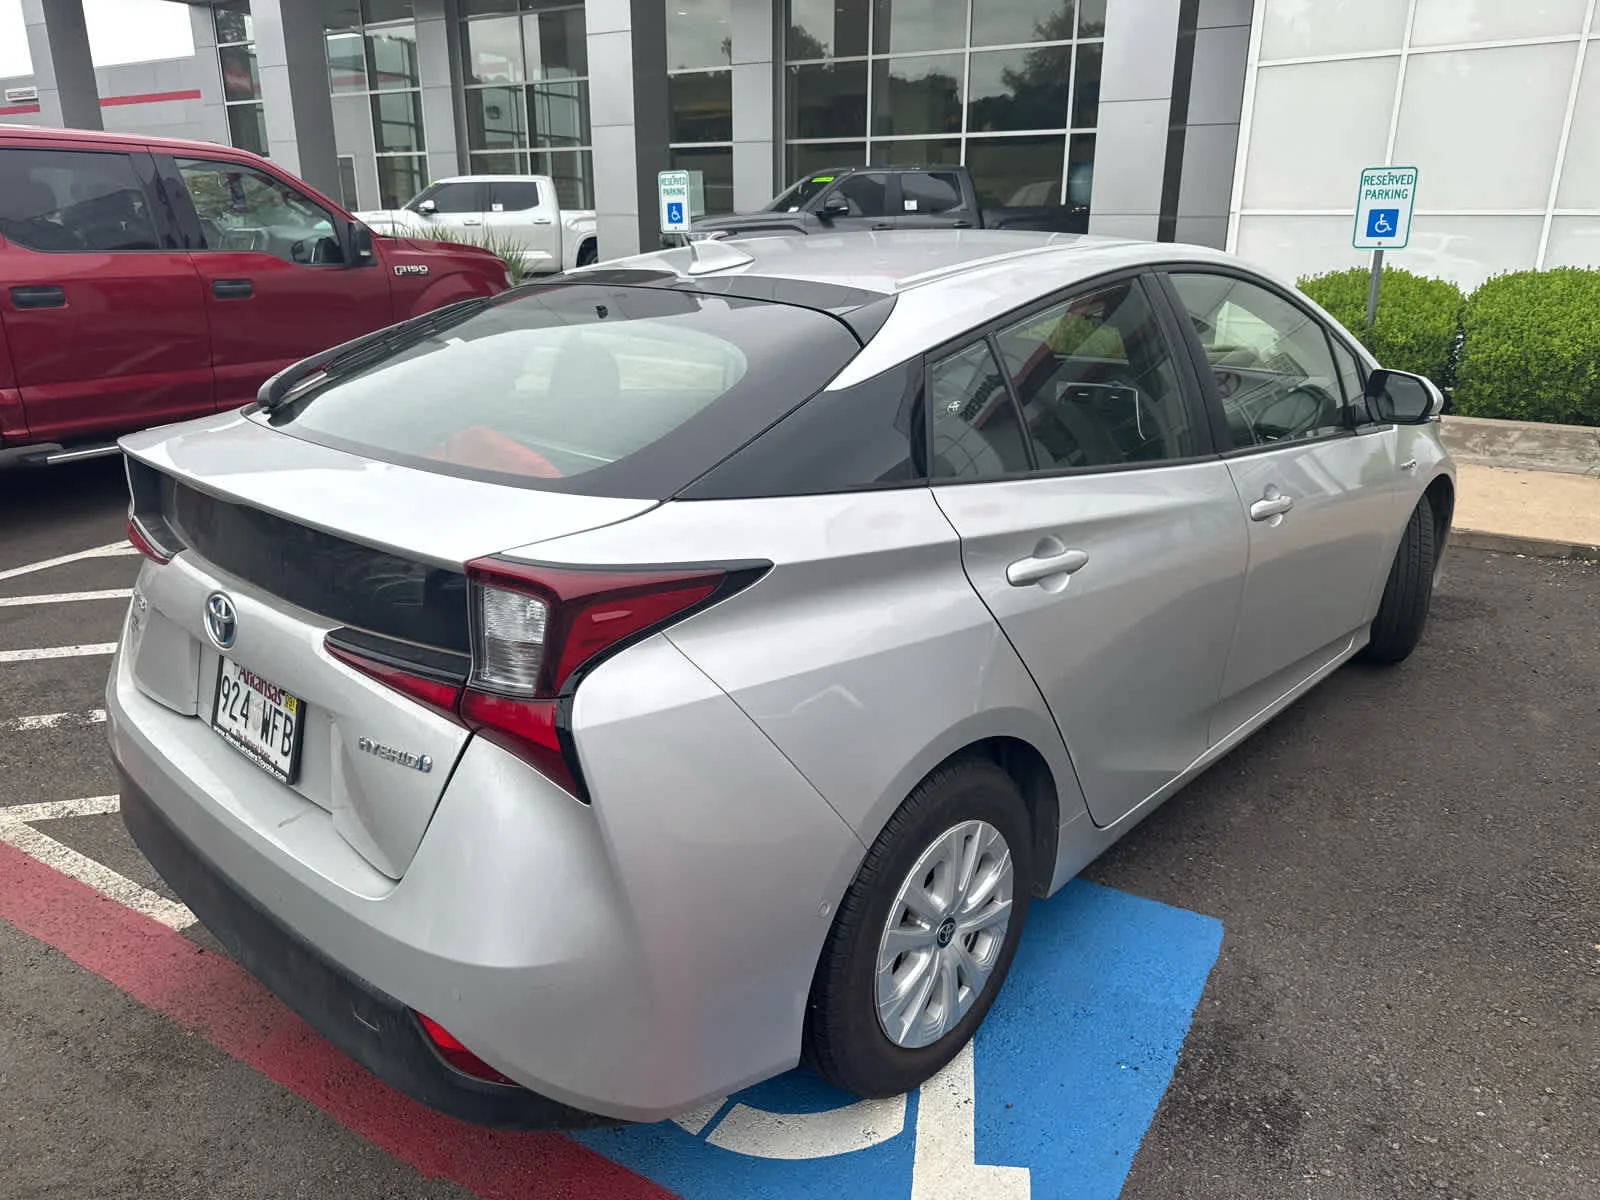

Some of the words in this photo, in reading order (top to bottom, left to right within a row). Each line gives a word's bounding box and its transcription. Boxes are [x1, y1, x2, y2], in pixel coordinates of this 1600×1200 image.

[661, 177, 687, 185] RESERVED
[1364, 174, 1414, 185] RESERVED
[663, 187, 685, 195] PARKING
[1365, 189, 1408, 200] PARKING
[239, 665, 282, 706] Arkansas
[221, 675, 251, 729] 924
[260, 699, 294, 757] WFB
[359, 736, 418, 769] HYBRID
